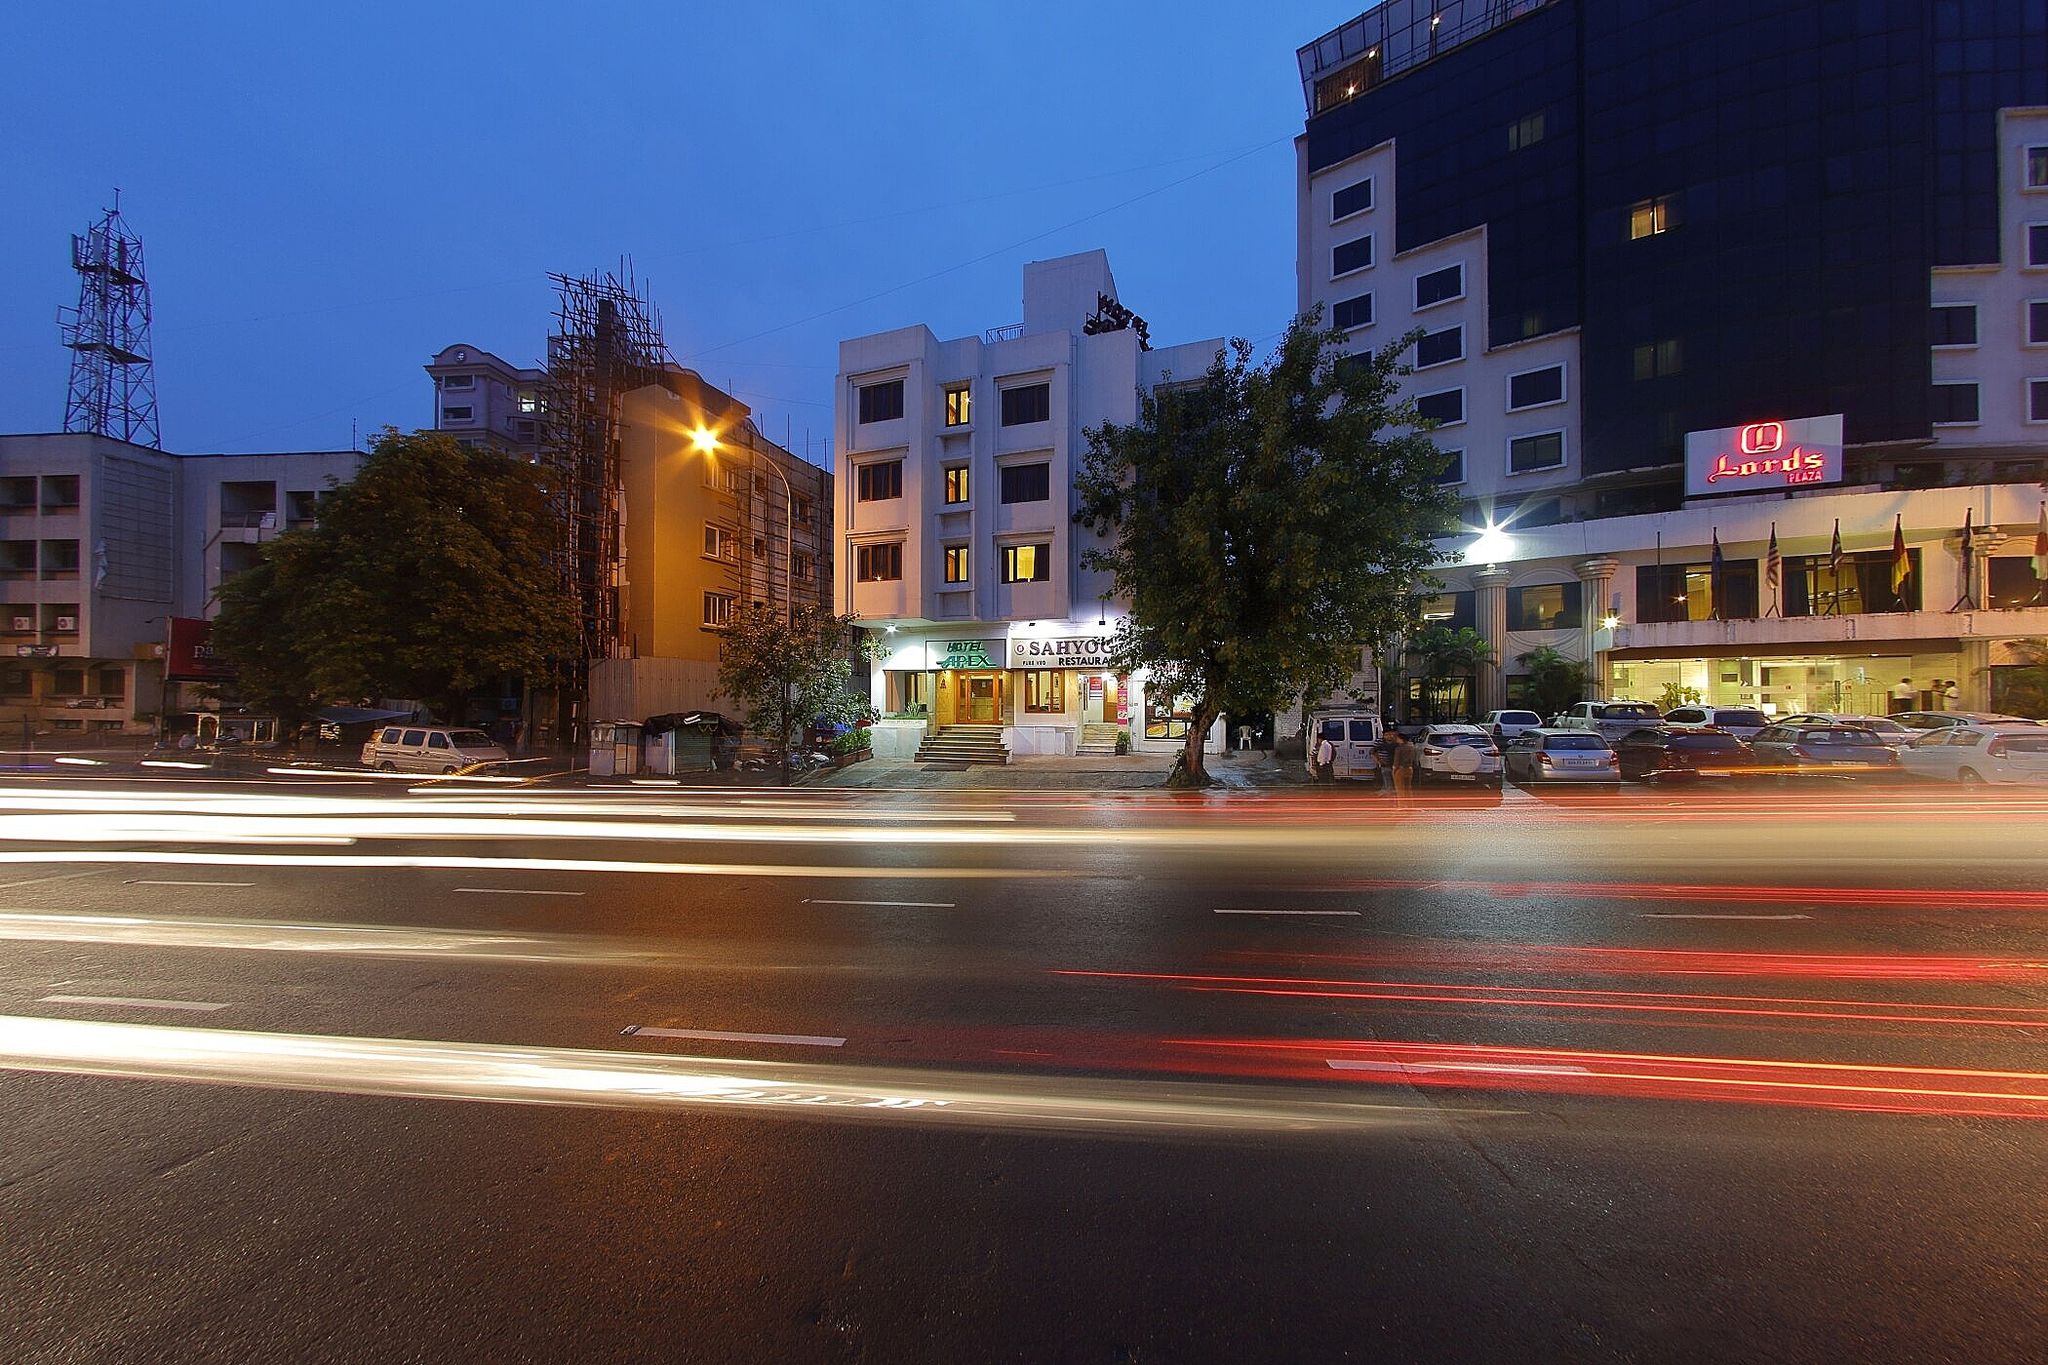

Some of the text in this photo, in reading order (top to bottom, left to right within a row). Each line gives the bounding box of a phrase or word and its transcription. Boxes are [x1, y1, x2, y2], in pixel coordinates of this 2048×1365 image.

[1708, 446, 1824, 482] Lords
[1788, 471, 1822, 483] PLAZA
[946, 641, 985, 652] HOTEL
[936, 654, 997, 669] APEX
